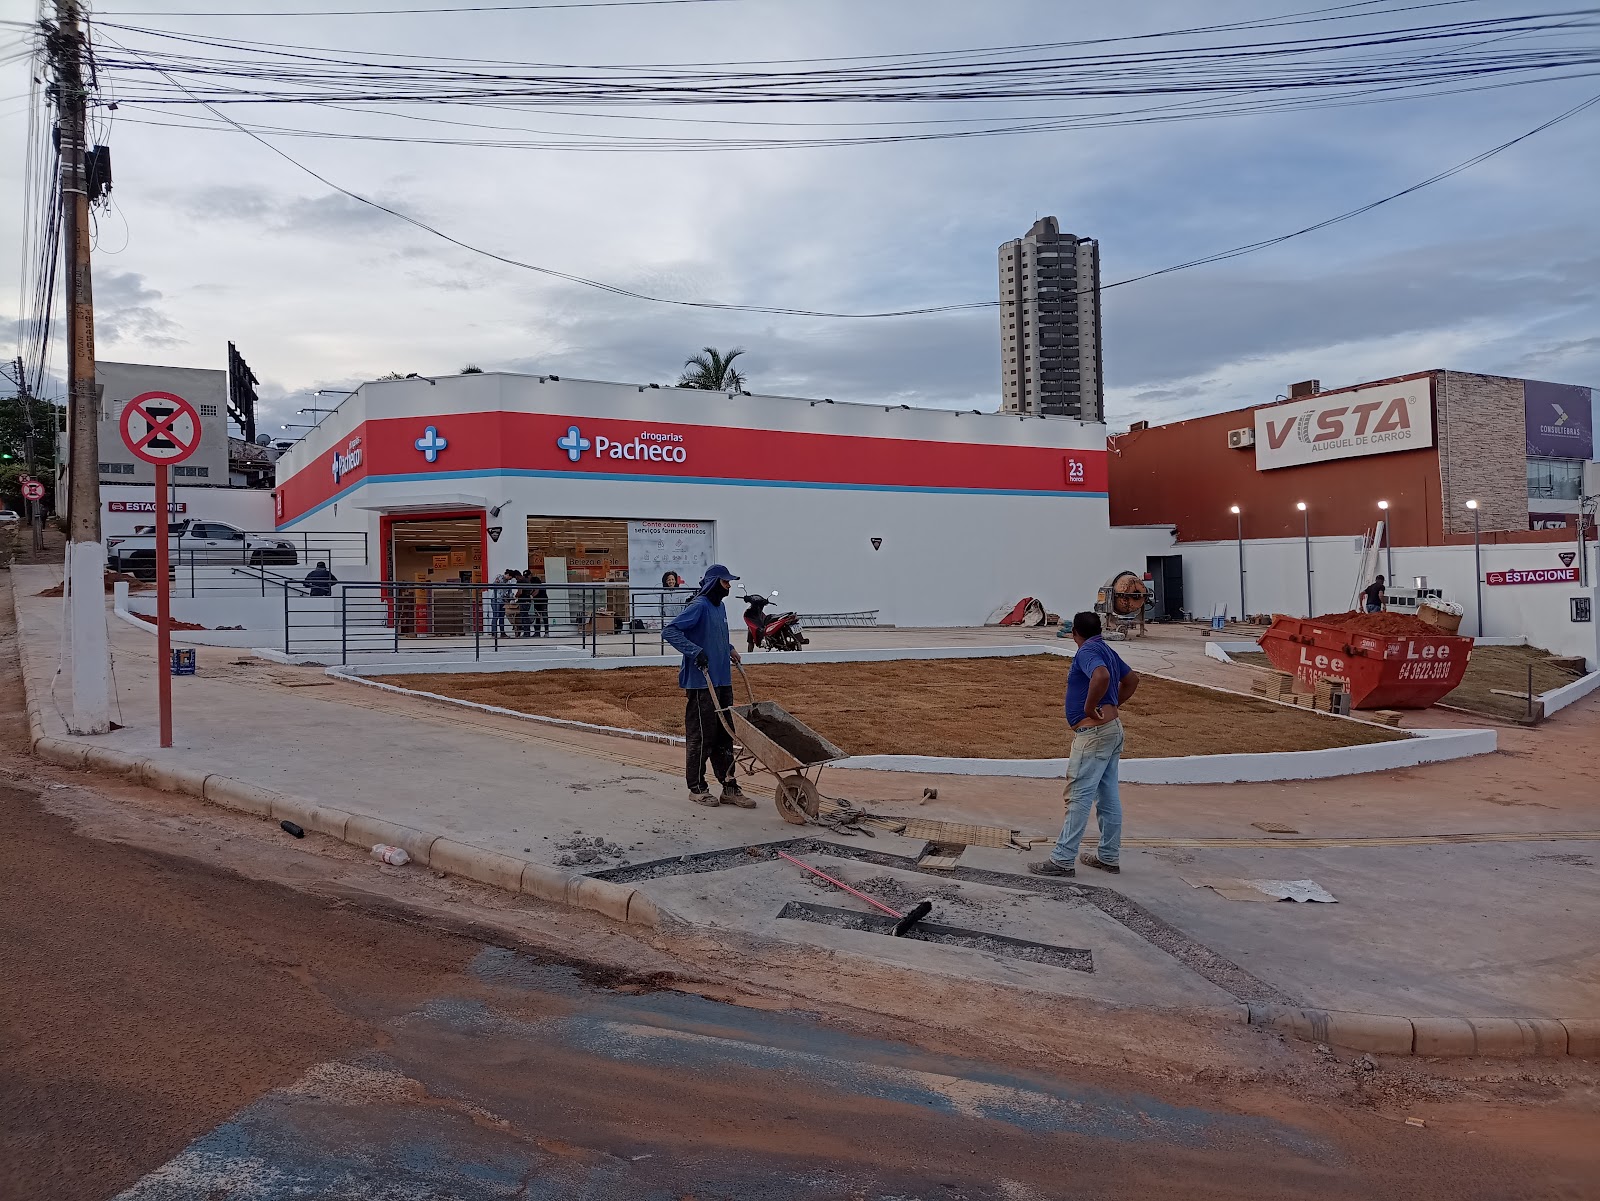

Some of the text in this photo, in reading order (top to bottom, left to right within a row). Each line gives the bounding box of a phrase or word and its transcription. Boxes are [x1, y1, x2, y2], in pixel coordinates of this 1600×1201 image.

[1265, 397, 1411, 450] VISTA
[1540, 425, 1580, 436] CONSULTEBRAS
[640, 430, 683, 442] drogarias
[1311, 430, 1412, 453] ALUGUEL DE CARROS
[595, 436, 687, 463] Pacheco
[1068, 462, 1084, 476] 23
[634, 527, 706, 535] serviços farmacêuticos
[641, 520, 662, 528] Conte
[1505, 569, 1575, 583] ESTACIONE
[1406, 640, 1450, 660] Lee
[1299, 646, 1345, 673] Lee
[1399, 662, 1411, 680] 64
